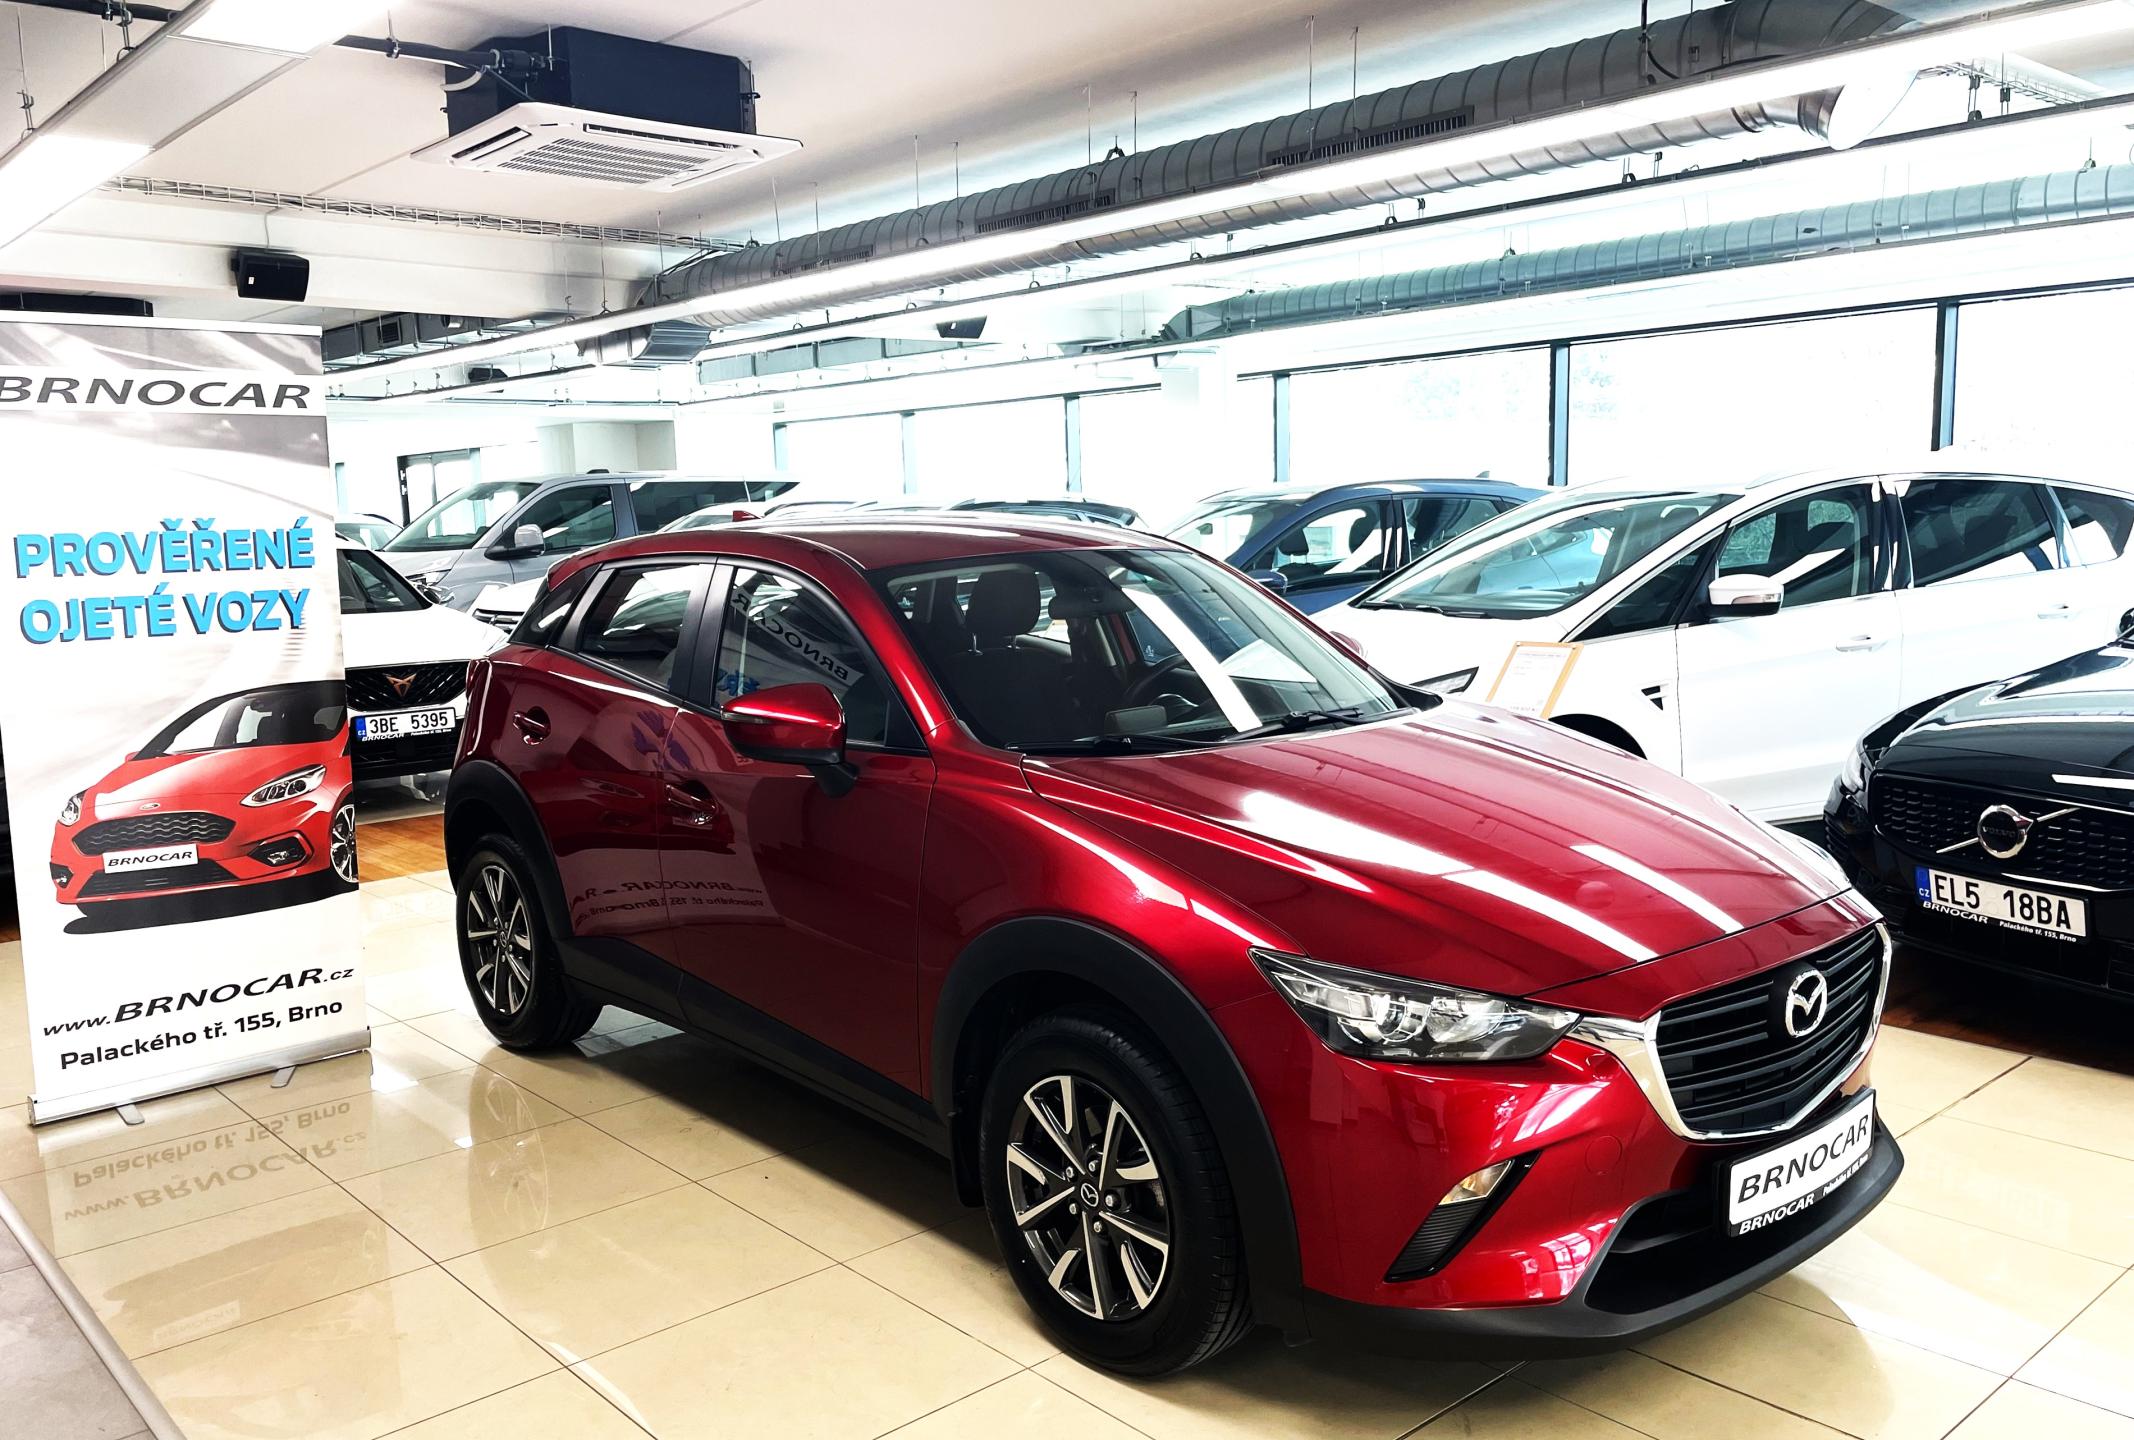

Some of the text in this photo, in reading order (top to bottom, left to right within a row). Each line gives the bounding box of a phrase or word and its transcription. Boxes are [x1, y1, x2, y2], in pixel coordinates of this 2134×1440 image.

[0, 375, 311, 409] BRNOCAR
[14, 516, 316, 579] PROVĚŘENÉ
[20, 582, 311, 644] OJETÉ VOZY
[369, 717, 399, 734] 3BE
[411, 711, 448, 730] 5395
[107, 850, 194, 867] BRNOCAR
[1918, 874, 2072, 930] CZ EL5 18BA
[1922, 900, 1989, 924] BRNOCAR
[1999, 920, 2034, 935] Palackého
[2059, 933, 2077, 943] Brno
[43, 966, 356, 1037] www.BRNOCAR.cz
[60, 999, 344, 1070] Palackého tř. 155, Brno
[1737, 1114, 1869, 1204] BRNOCAR
[1738, 1192, 1816, 1235] BRNOCAR
